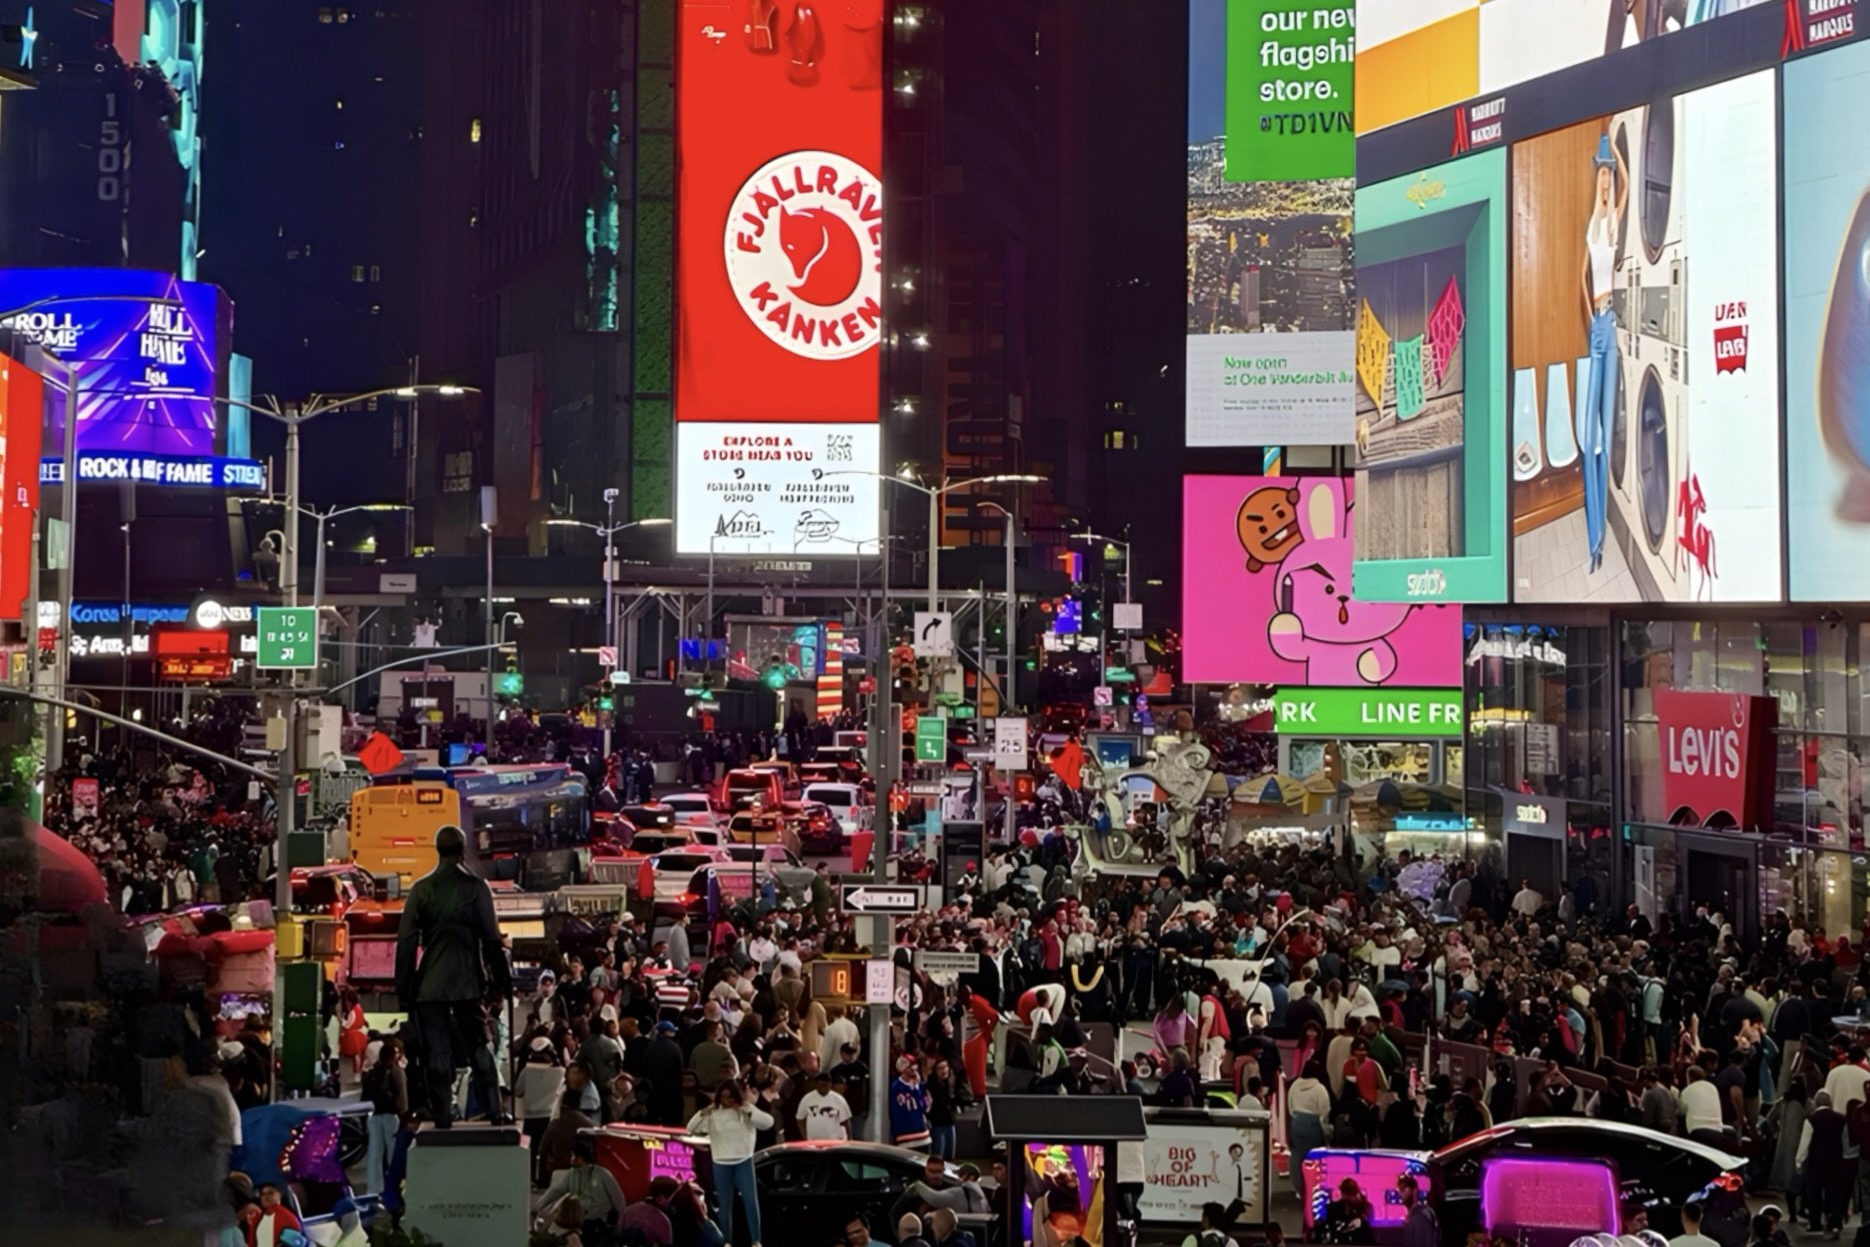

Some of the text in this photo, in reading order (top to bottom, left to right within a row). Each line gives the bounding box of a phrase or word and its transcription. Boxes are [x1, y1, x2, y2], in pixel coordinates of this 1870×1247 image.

[1260, 9, 1307, 32] our
[1260, 79, 1339, 102] store.
[79, 457, 129, 478] ROCK
[165, 462, 214, 483] FAME
[1282, 702, 1461, 724] RK LINE FR
